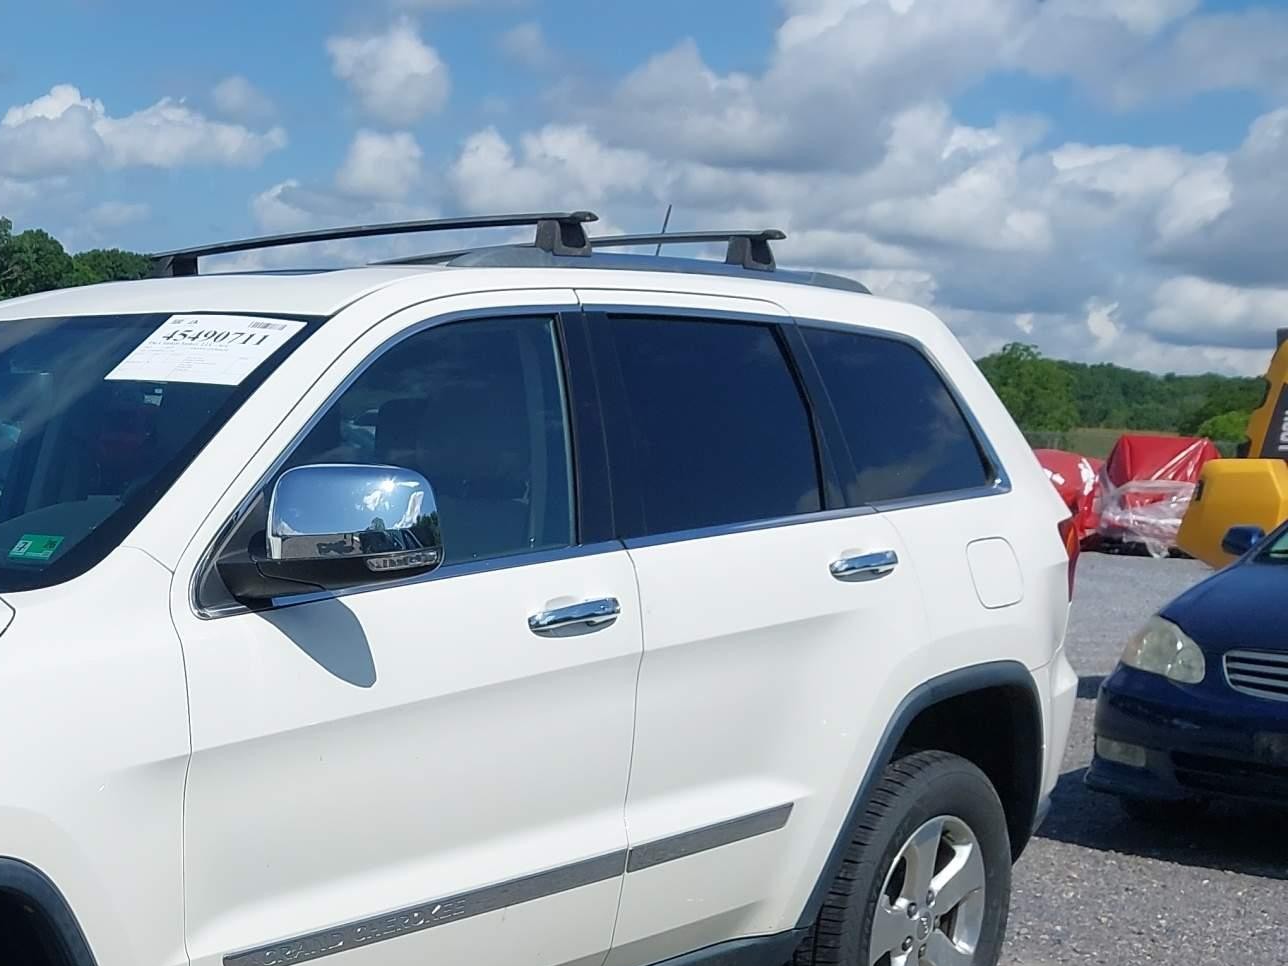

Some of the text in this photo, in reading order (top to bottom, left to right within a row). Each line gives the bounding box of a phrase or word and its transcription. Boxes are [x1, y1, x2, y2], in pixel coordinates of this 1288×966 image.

[162, 329, 270, 346] 45490711
[264, 900, 465, 965] GRAND CHEROKEE
